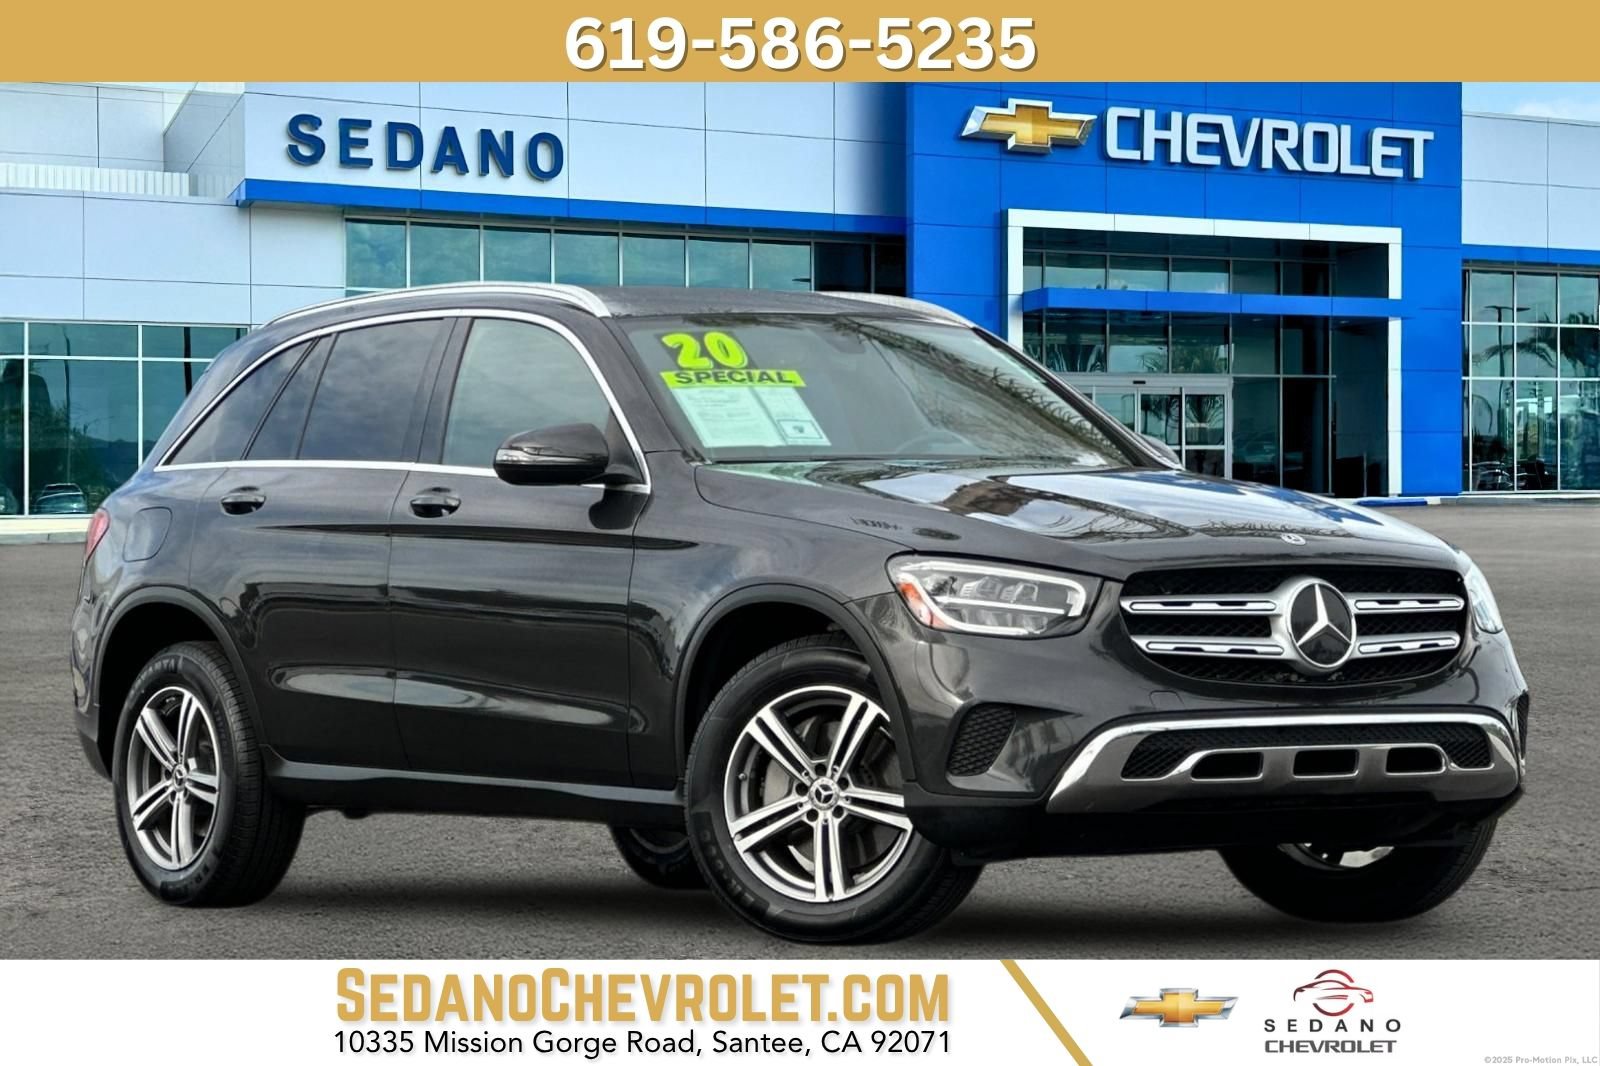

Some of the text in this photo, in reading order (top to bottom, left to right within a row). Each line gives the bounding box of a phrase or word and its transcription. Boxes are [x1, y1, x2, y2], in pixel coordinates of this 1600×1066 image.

[287, 113, 564, 181] SEDANO
[1105, 106, 1434, 179] CHEVROLET
[661, 331, 748, 370] 20
[674, 371, 797, 384] SPECIAL
